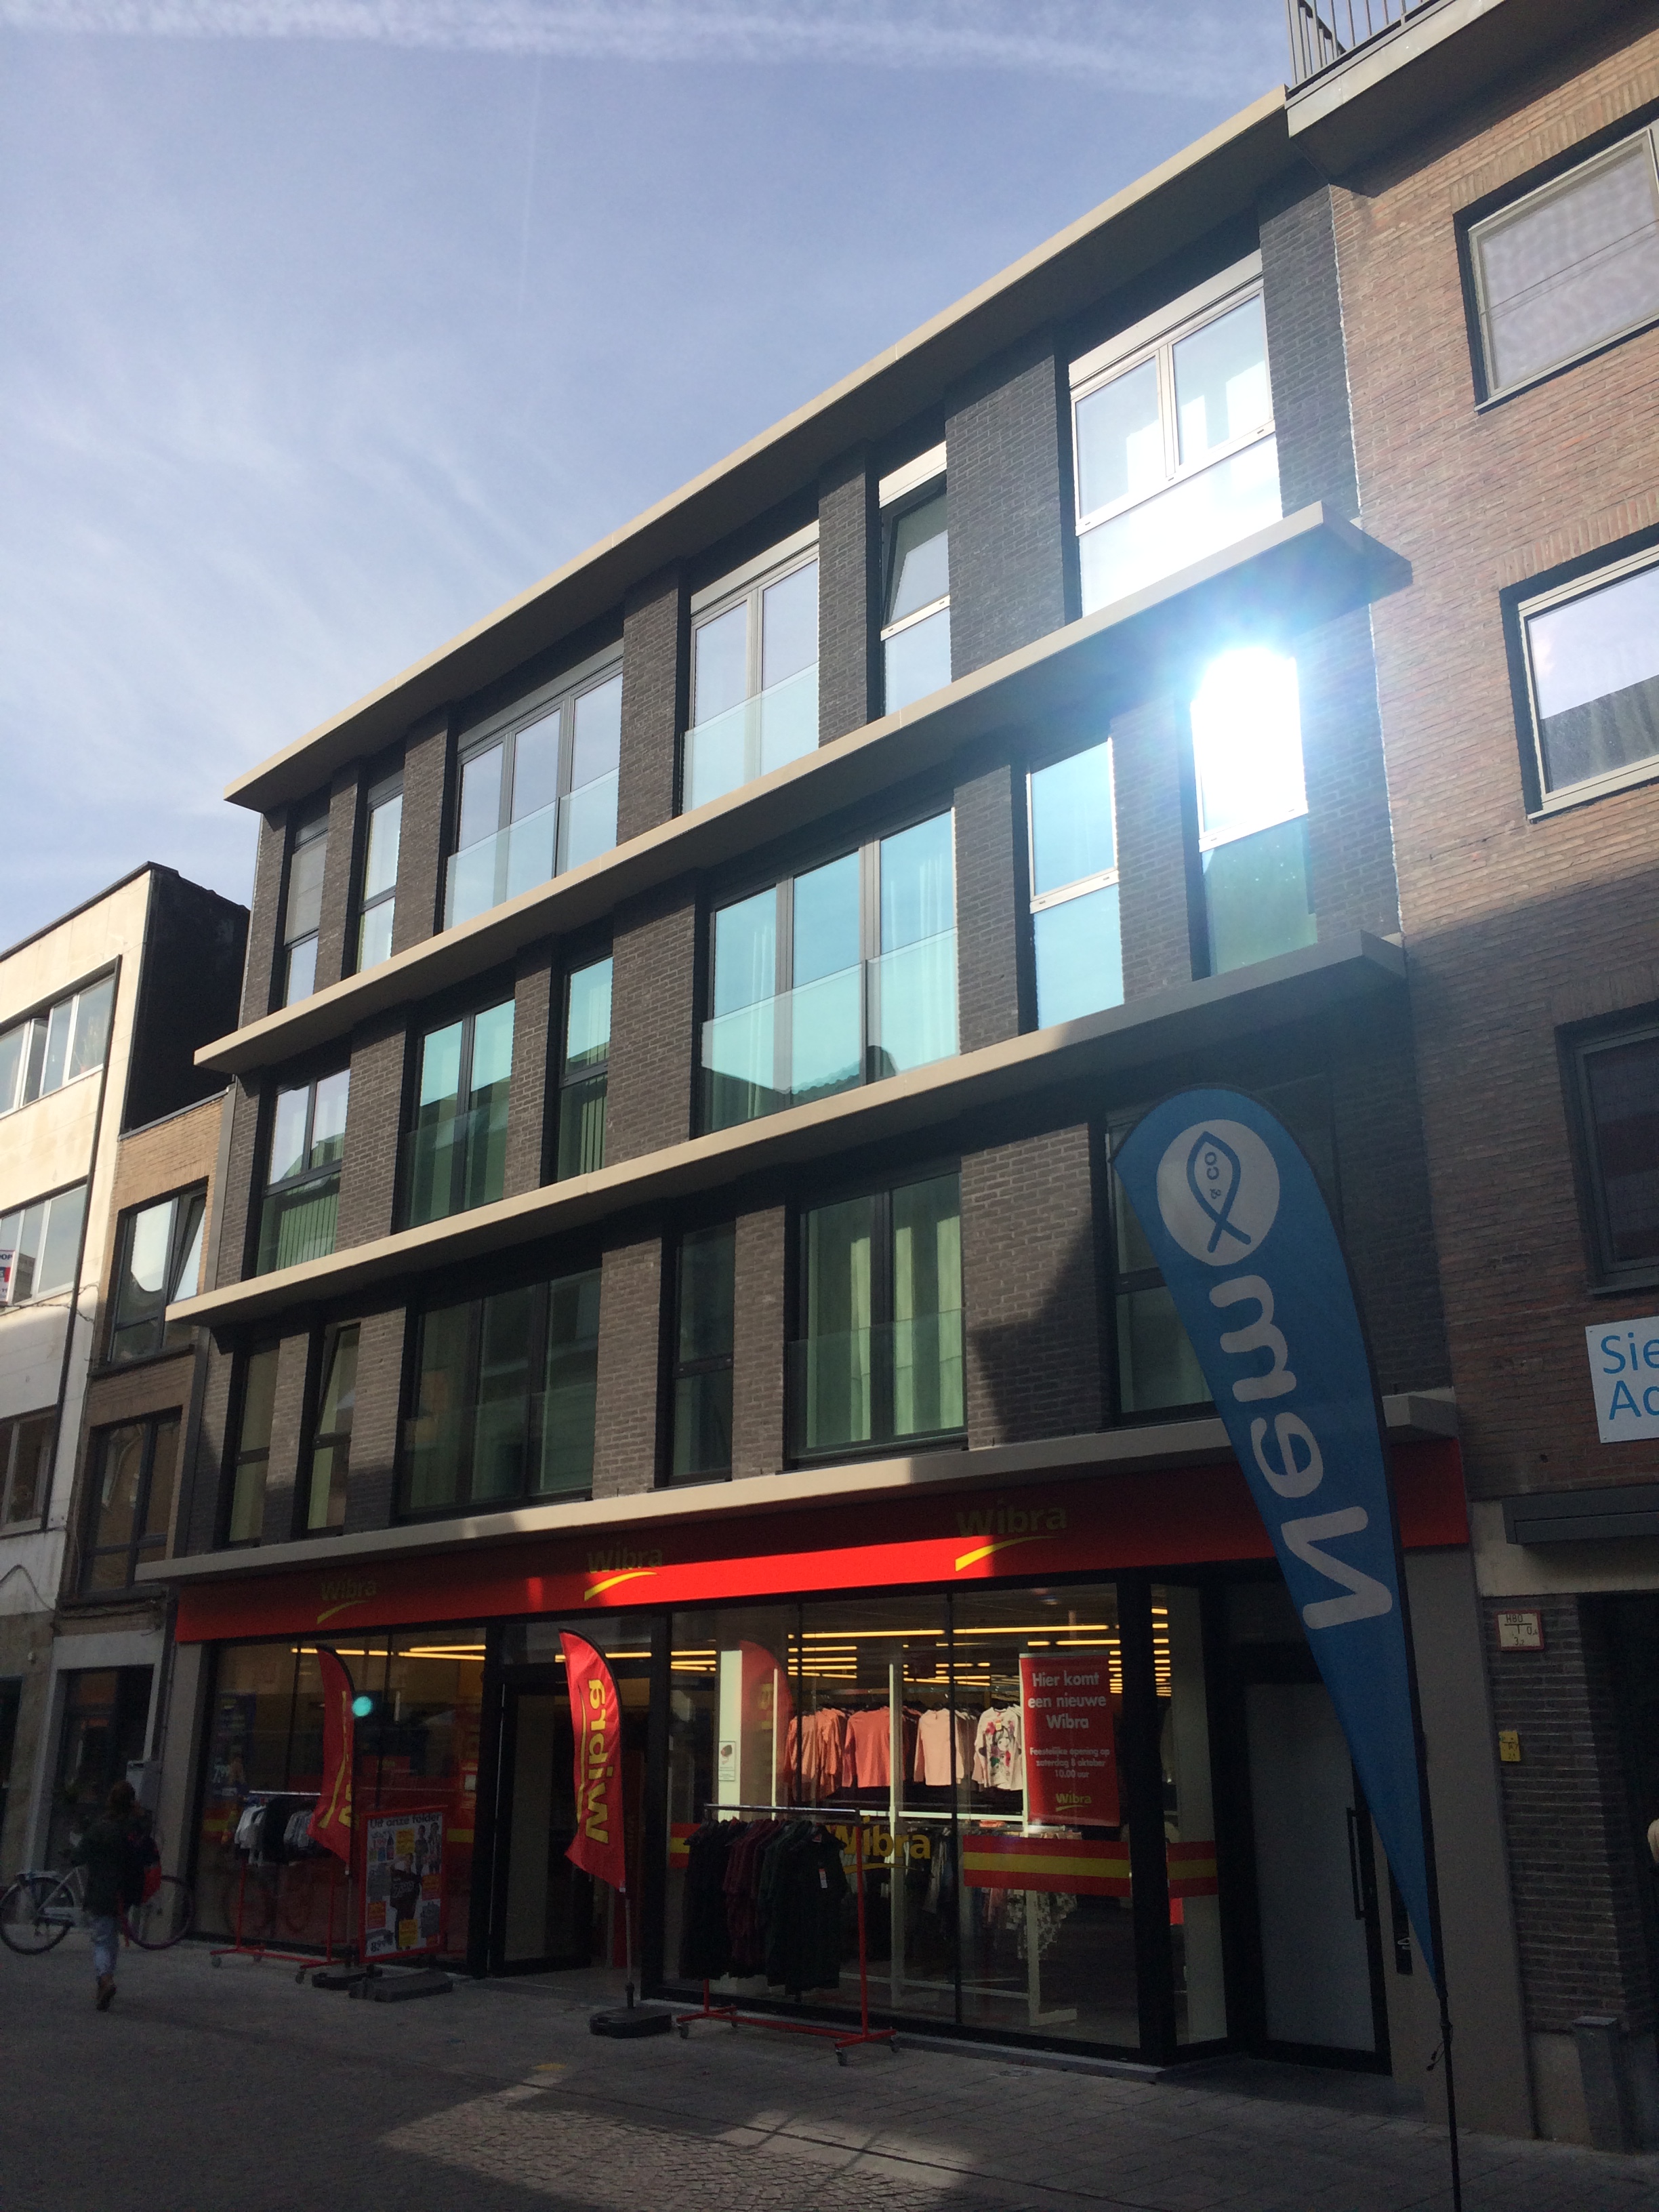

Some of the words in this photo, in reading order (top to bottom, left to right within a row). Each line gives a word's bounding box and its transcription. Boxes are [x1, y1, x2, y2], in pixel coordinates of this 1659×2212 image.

[956, 1498, 1067, 1537] Wibra
[586, 1541, 663, 1574] Wibra
[1032, 1672, 1060, 1687] Hier
[1063, 1670, 1099, 1686] komt
[1027, 1698, 1052, 1708] een
[1056, 1692, 1107, 1707] nieuwe
[1046, 1713, 1089, 1729] Wibra
[1055, 1790, 1092, 1804] Wibra
